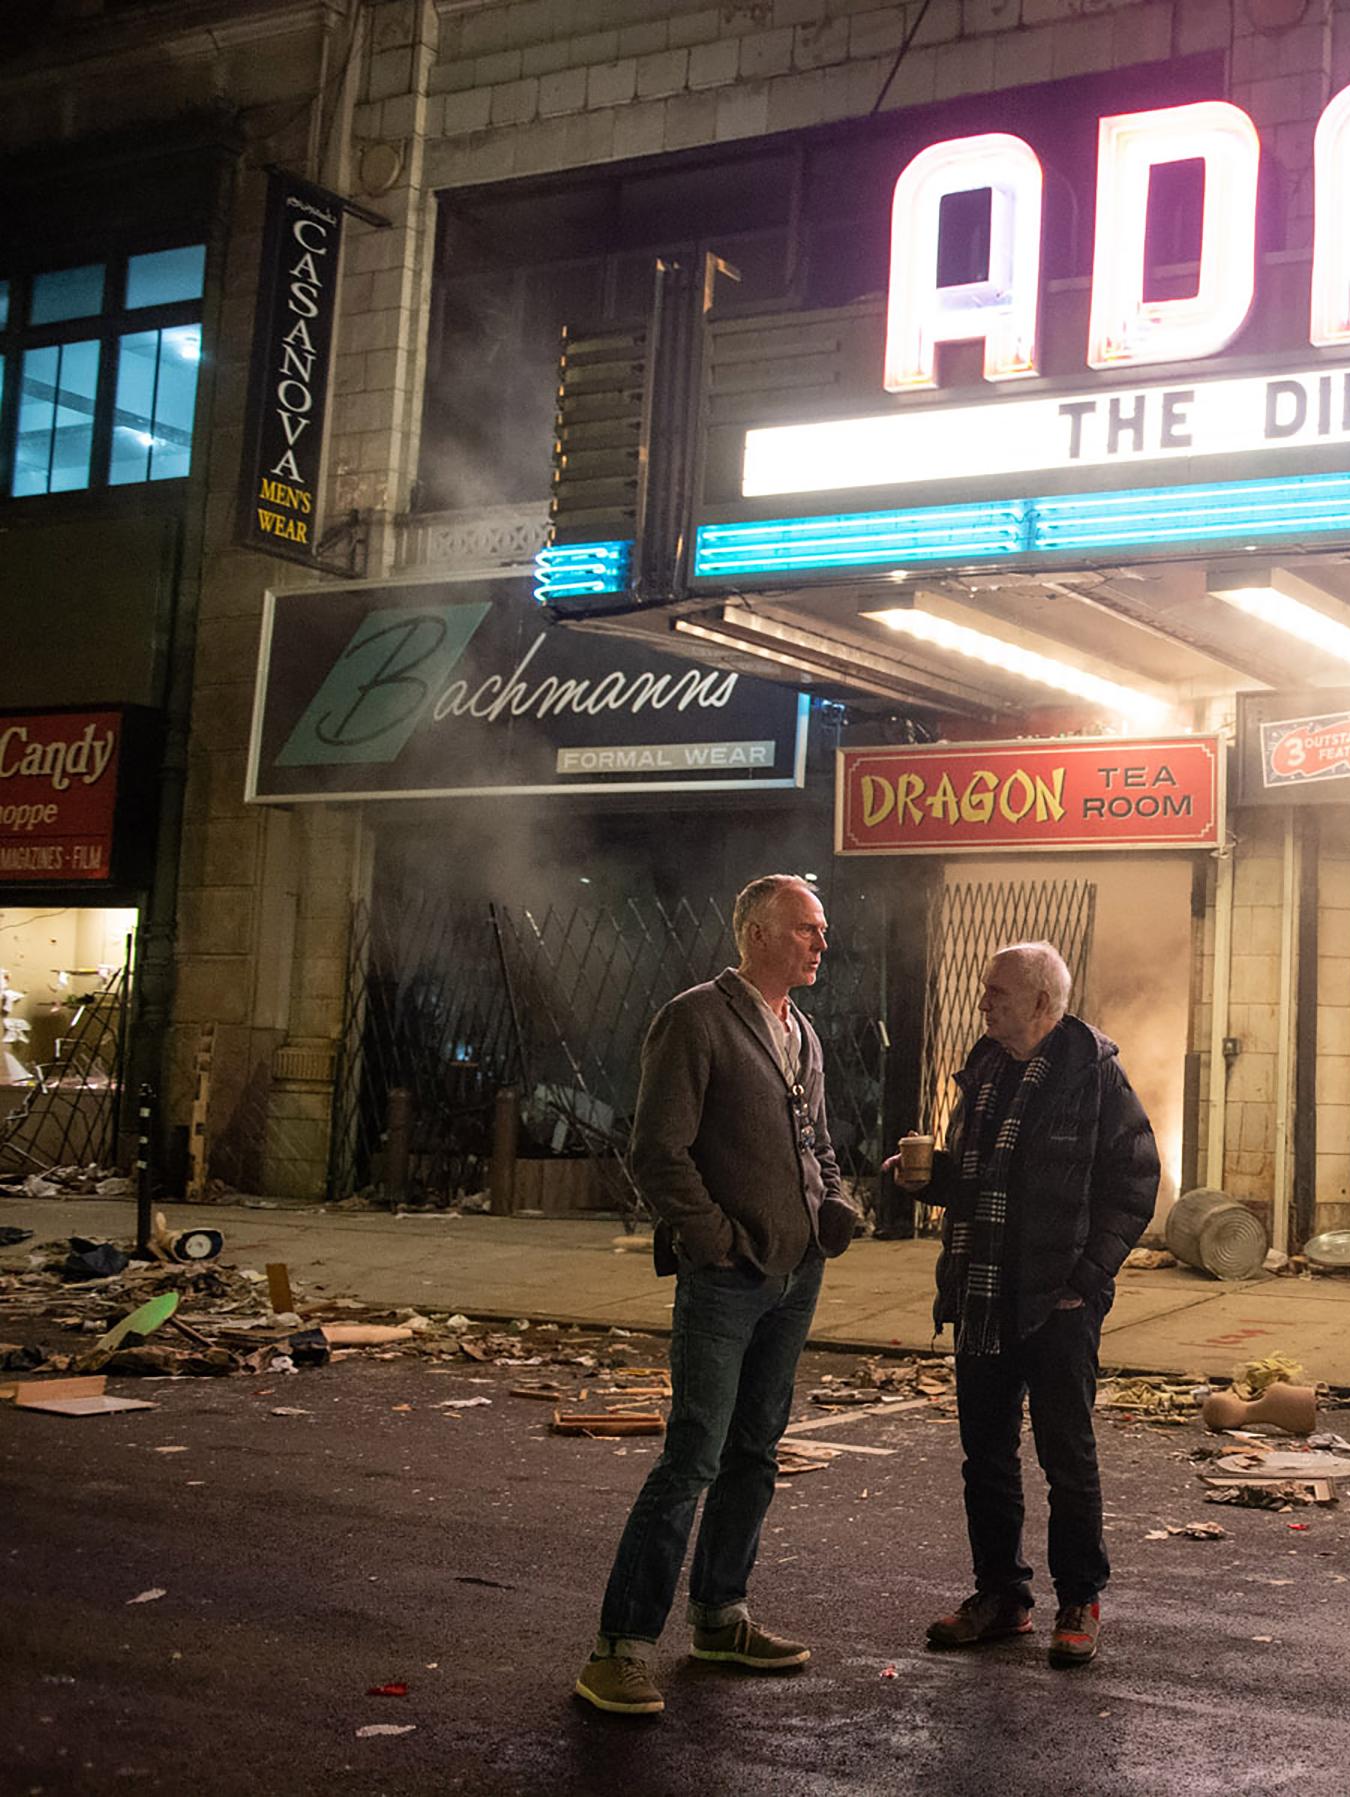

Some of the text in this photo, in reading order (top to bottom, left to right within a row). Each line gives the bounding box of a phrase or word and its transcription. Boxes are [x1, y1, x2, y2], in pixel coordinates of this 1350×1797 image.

[272, 220, 327, 482] CASANOVA
[1059, 390, 1195, 459] THE
[260, 477, 312, 515] MEN'S
[257, 508, 308, 545] WEAR
[315, 615, 738, 746] Bachmanns
[0, 723, 115, 790] Candy
[563, 746, 767, 769] FORMAL WEAR
[1285, 737, 1306, 766] 3
[1097, 765, 1177, 788] TEA
[860, 767, 1066, 827] DRAGON
[1083, 795, 1193, 819] ROOM
